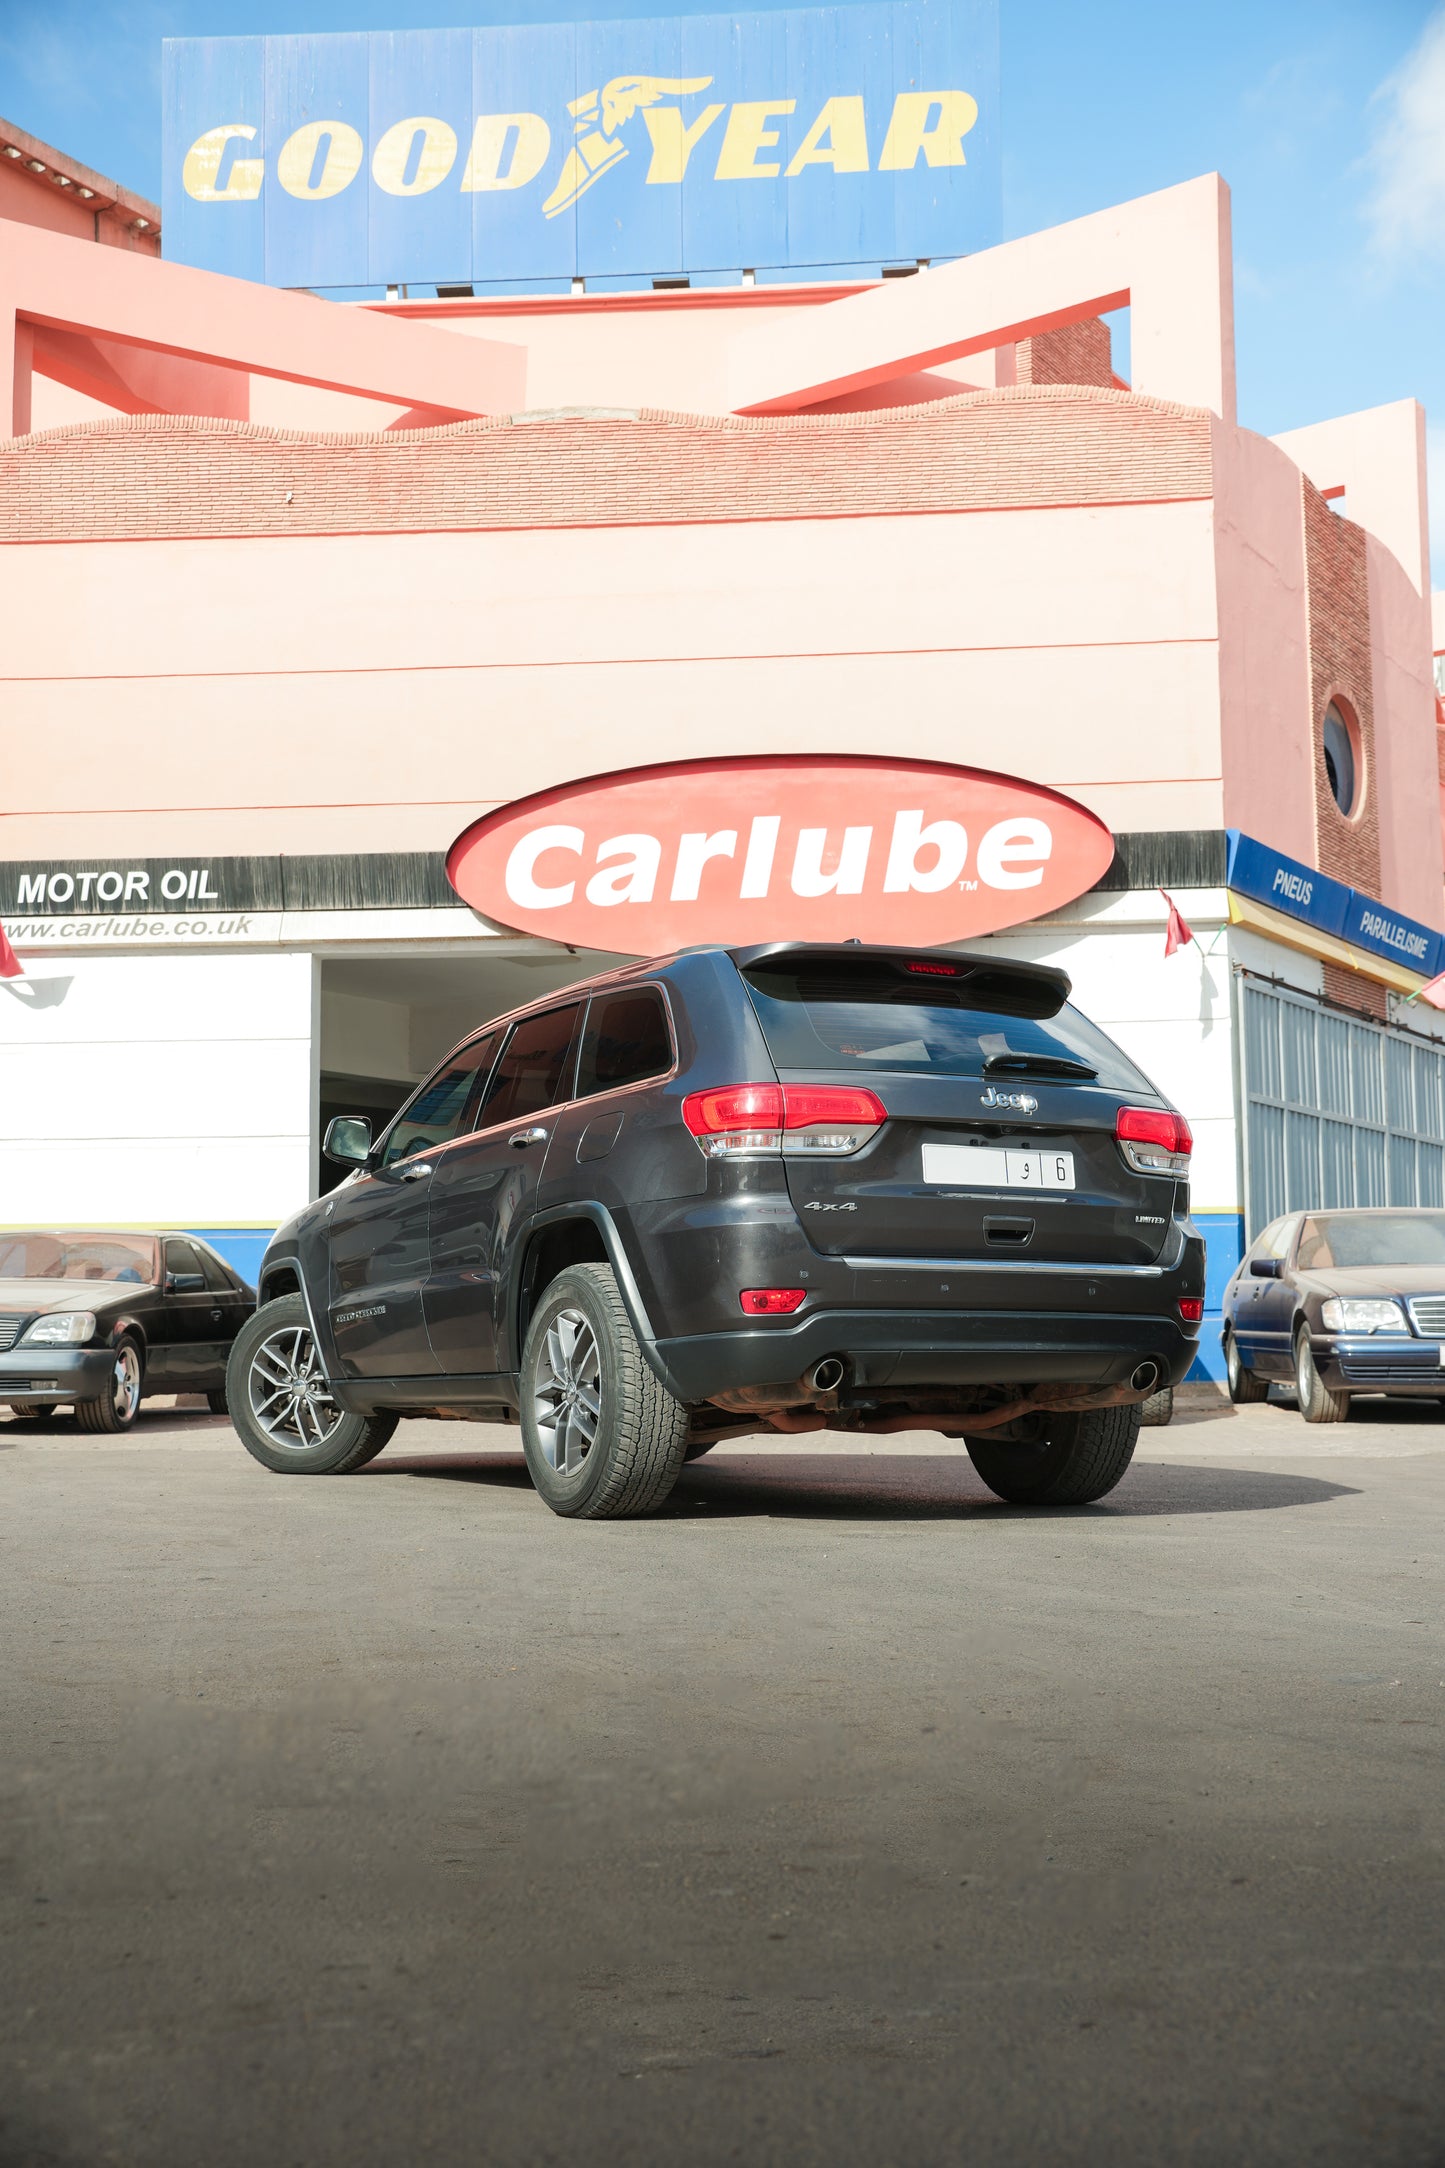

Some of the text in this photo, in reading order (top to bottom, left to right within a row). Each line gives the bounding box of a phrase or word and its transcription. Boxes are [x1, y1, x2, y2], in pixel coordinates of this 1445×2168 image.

[505, 810, 1053, 910] Carlube
[17, 870, 219, 904] MOTOR OIL
[1272, 868, 1313, 906] PNEUS
[2, 915, 253, 938] ww.carlube.co.uk
[1359, 911, 1429, 960] PARALLELISME
[980, 1086, 1038, 1116] Jeep
[1055, 1157, 1066, 1181] 6
[803, 1201, 858, 1211] 4x4
